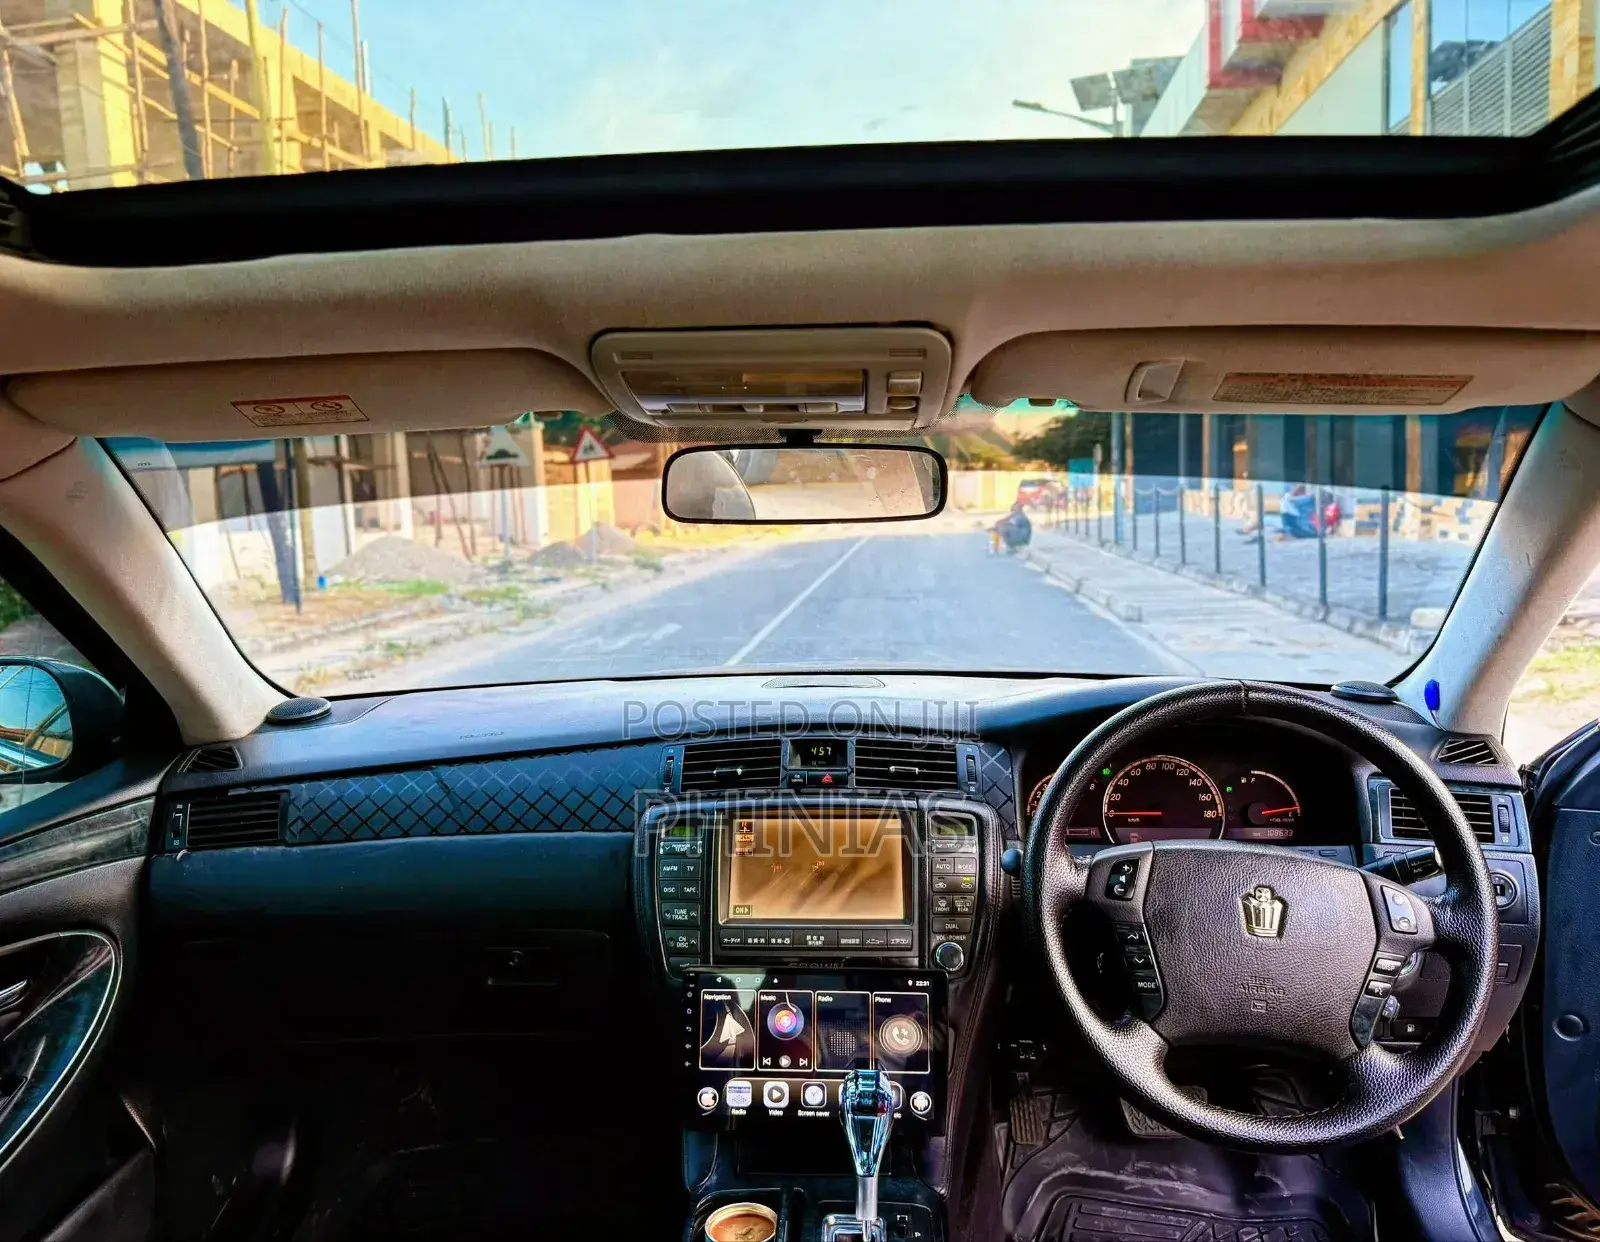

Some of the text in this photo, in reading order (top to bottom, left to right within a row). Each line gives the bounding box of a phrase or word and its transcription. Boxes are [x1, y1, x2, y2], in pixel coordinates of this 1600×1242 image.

[1145, 762, 1157, 770] 80
[1161, 762, 1175, 770] 100
[1130, 768, 1141, 776] 60
[1176, 768, 1190, 776] 120
[1117, 778, 1129, 786] 40
[1189, 778, 1202, 786] 140
[1110, 793, 1121, 801] 20
[1198, 793, 1212, 801] 160
[1203, 810, 1217, 818] 180
[1137, 981, 1156, 989] MODE
[703, 993, 732, 1002] Navigation
[760, 994, 777, 1002] Music
[817, 995, 834, 1003] Radio
[731, 1108, 747, 1116] Radio
[768, 1109, 784, 1117] Video
